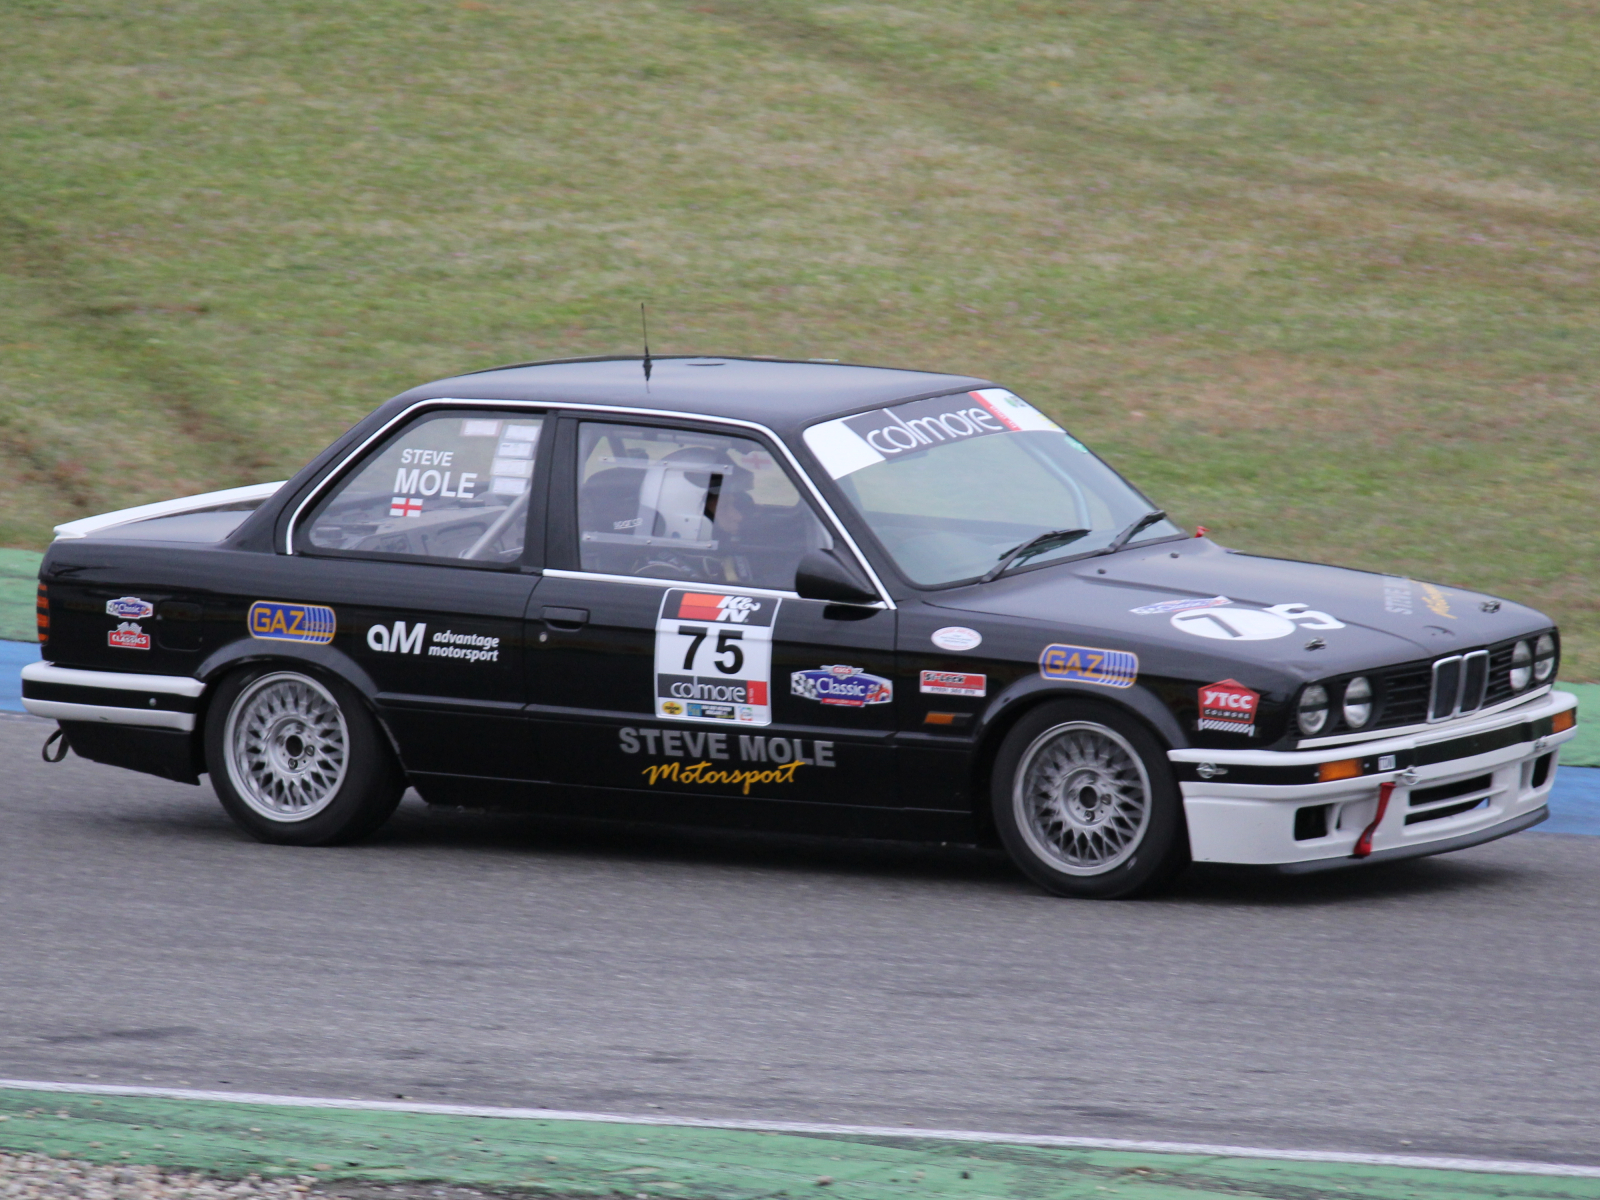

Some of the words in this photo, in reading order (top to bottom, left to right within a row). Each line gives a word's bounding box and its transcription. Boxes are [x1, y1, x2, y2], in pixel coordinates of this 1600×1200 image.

[866, 408, 1004, 454] colmore
[401, 448, 454, 467] STEVE
[393, 468, 478, 499] MOLE
[253, 607, 306, 635] GAZ
[428, 645, 499, 663] motorsport
[433, 630, 500, 650] advantage
[677, 624, 744, 675] 75
[1045, 649, 1104, 678] GAZ
[670, 676, 746, 703] colmore
[816, 677, 866, 697] Classic
[1203, 690, 1254, 710] YTCC
[618, 726, 730, 760] STEVE
[738, 734, 836, 767] MOLE
[641, 759, 806, 795] Motorsport
